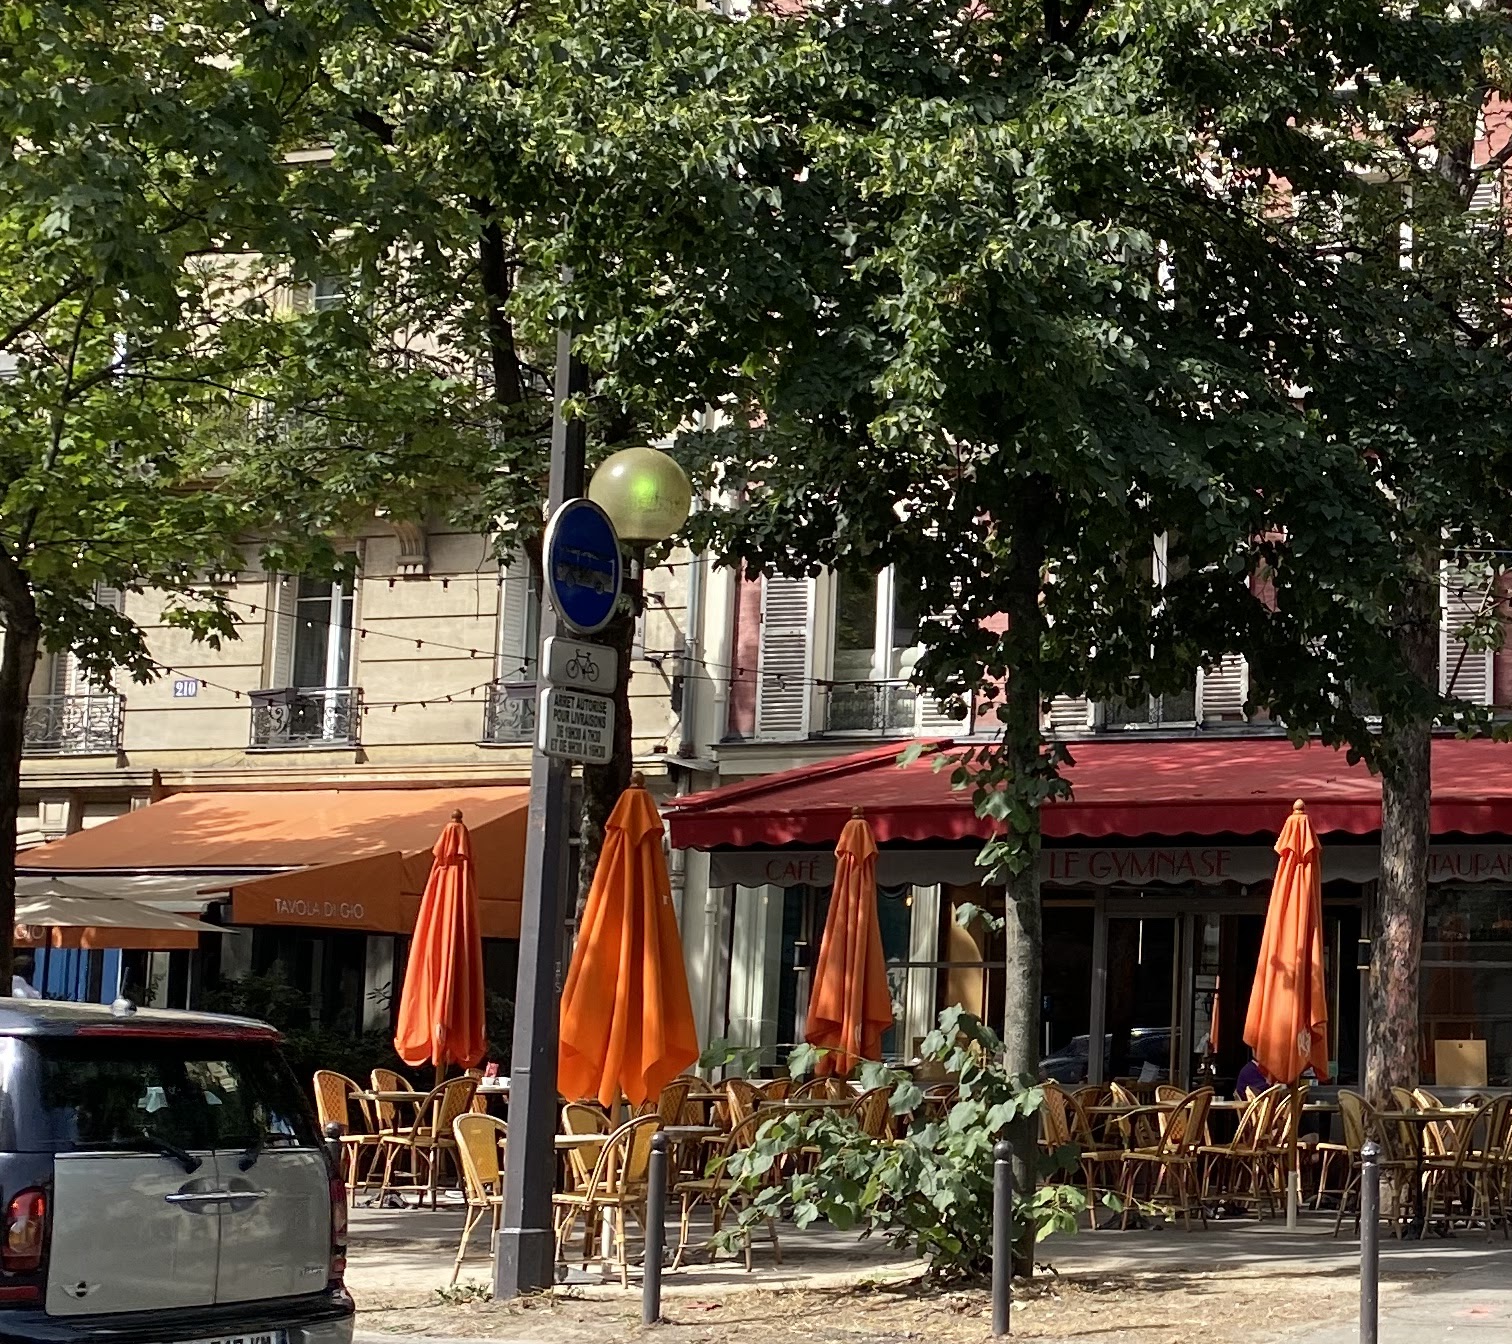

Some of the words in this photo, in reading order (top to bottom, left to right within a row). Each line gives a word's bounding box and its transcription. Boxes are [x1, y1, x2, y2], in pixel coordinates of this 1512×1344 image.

[175, 681, 197, 697] 210
[554, 693, 575, 709] ARRET
[577, 697, 607, 715] AUTORISE
[553, 708, 570, 723] POUR
[571, 711, 606, 729] LIVRAISONS
[556, 724, 564, 738] DE
[550, 738, 558, 752] ET
[559, 739, 567, 753] DE
[766, 855, 820, 881] CAFÉ
[1050, 850, 1080, 879] LE
[1088, 849, 1231, 879] GYMNASE
[274, 898, 320, 916] TAVOLA
[340, 902, 365, 919] GIO
